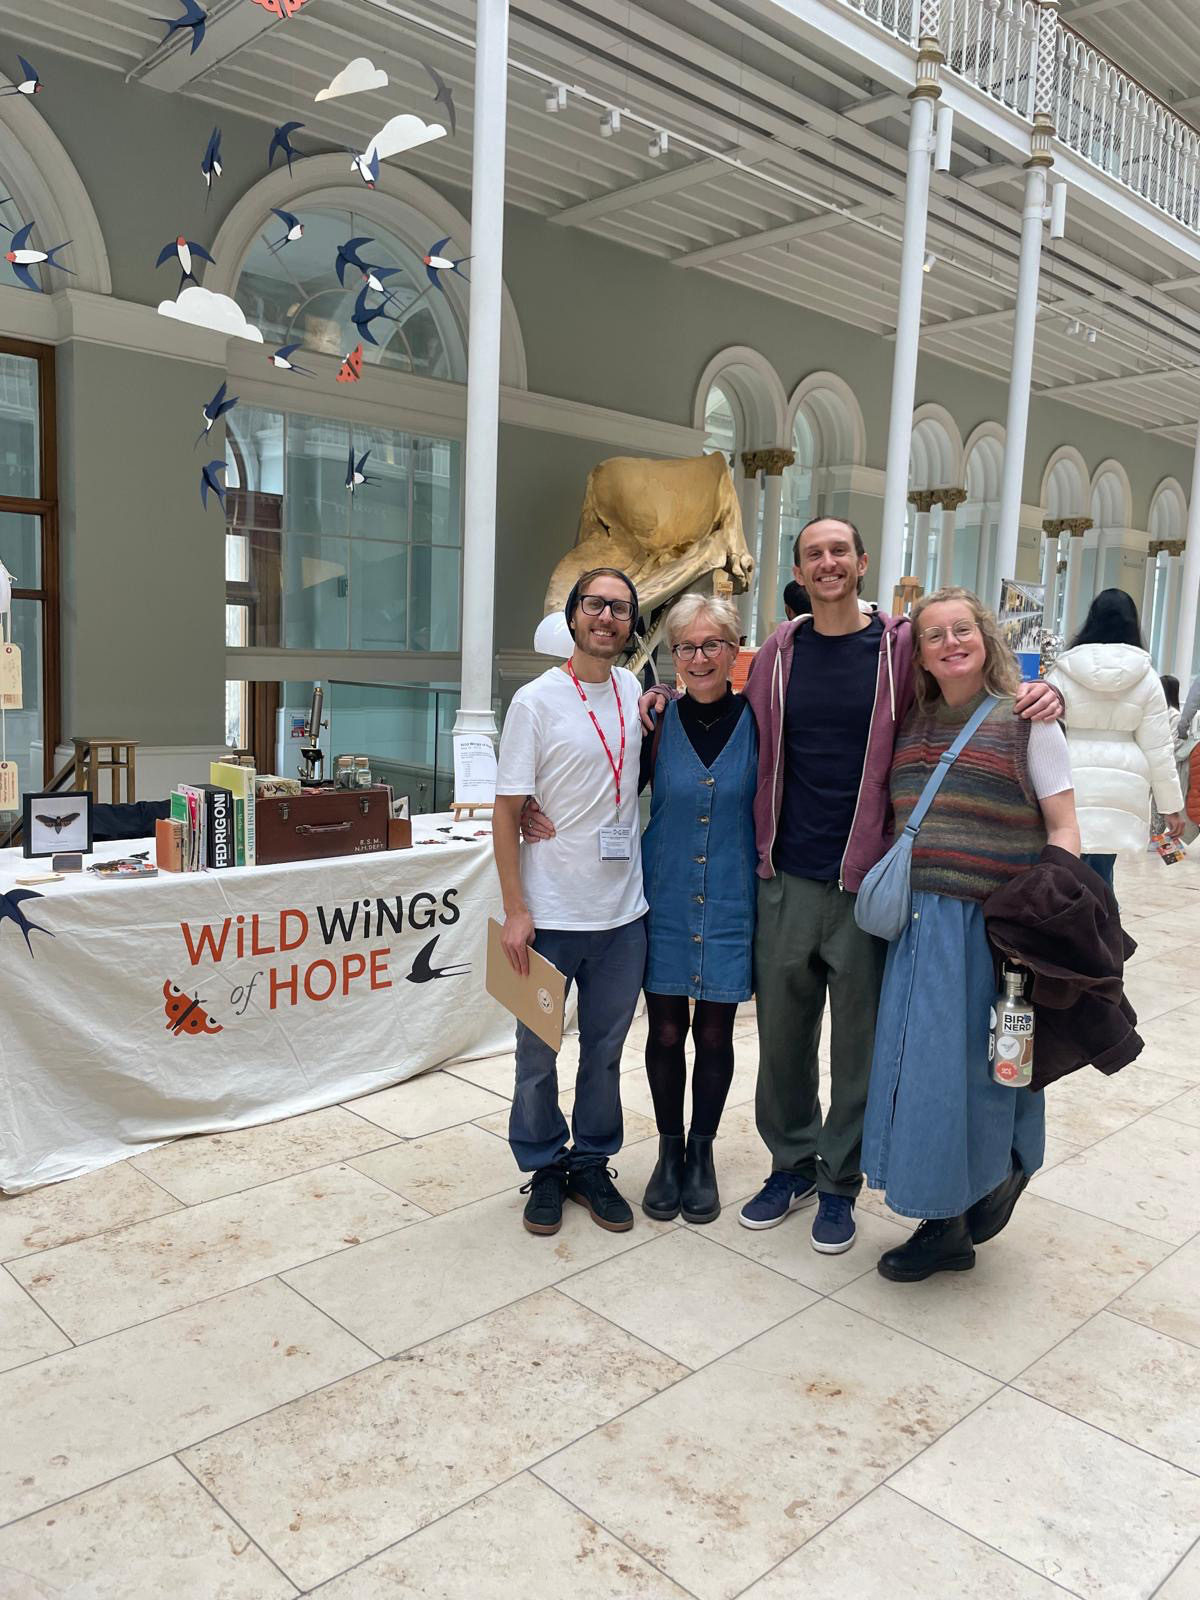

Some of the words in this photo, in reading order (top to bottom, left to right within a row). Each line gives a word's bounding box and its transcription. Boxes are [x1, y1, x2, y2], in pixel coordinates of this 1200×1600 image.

[214, 793, 227, 867] FEDRIGONI
[180, 908, 309, 966] WiLD
[316, 888, 460, 945] WiNGS
[230, 971, 264, 1016] of
[270, 948, 392, 1009] HOPE
[1004, 1023, 1032, 1032] NERD
